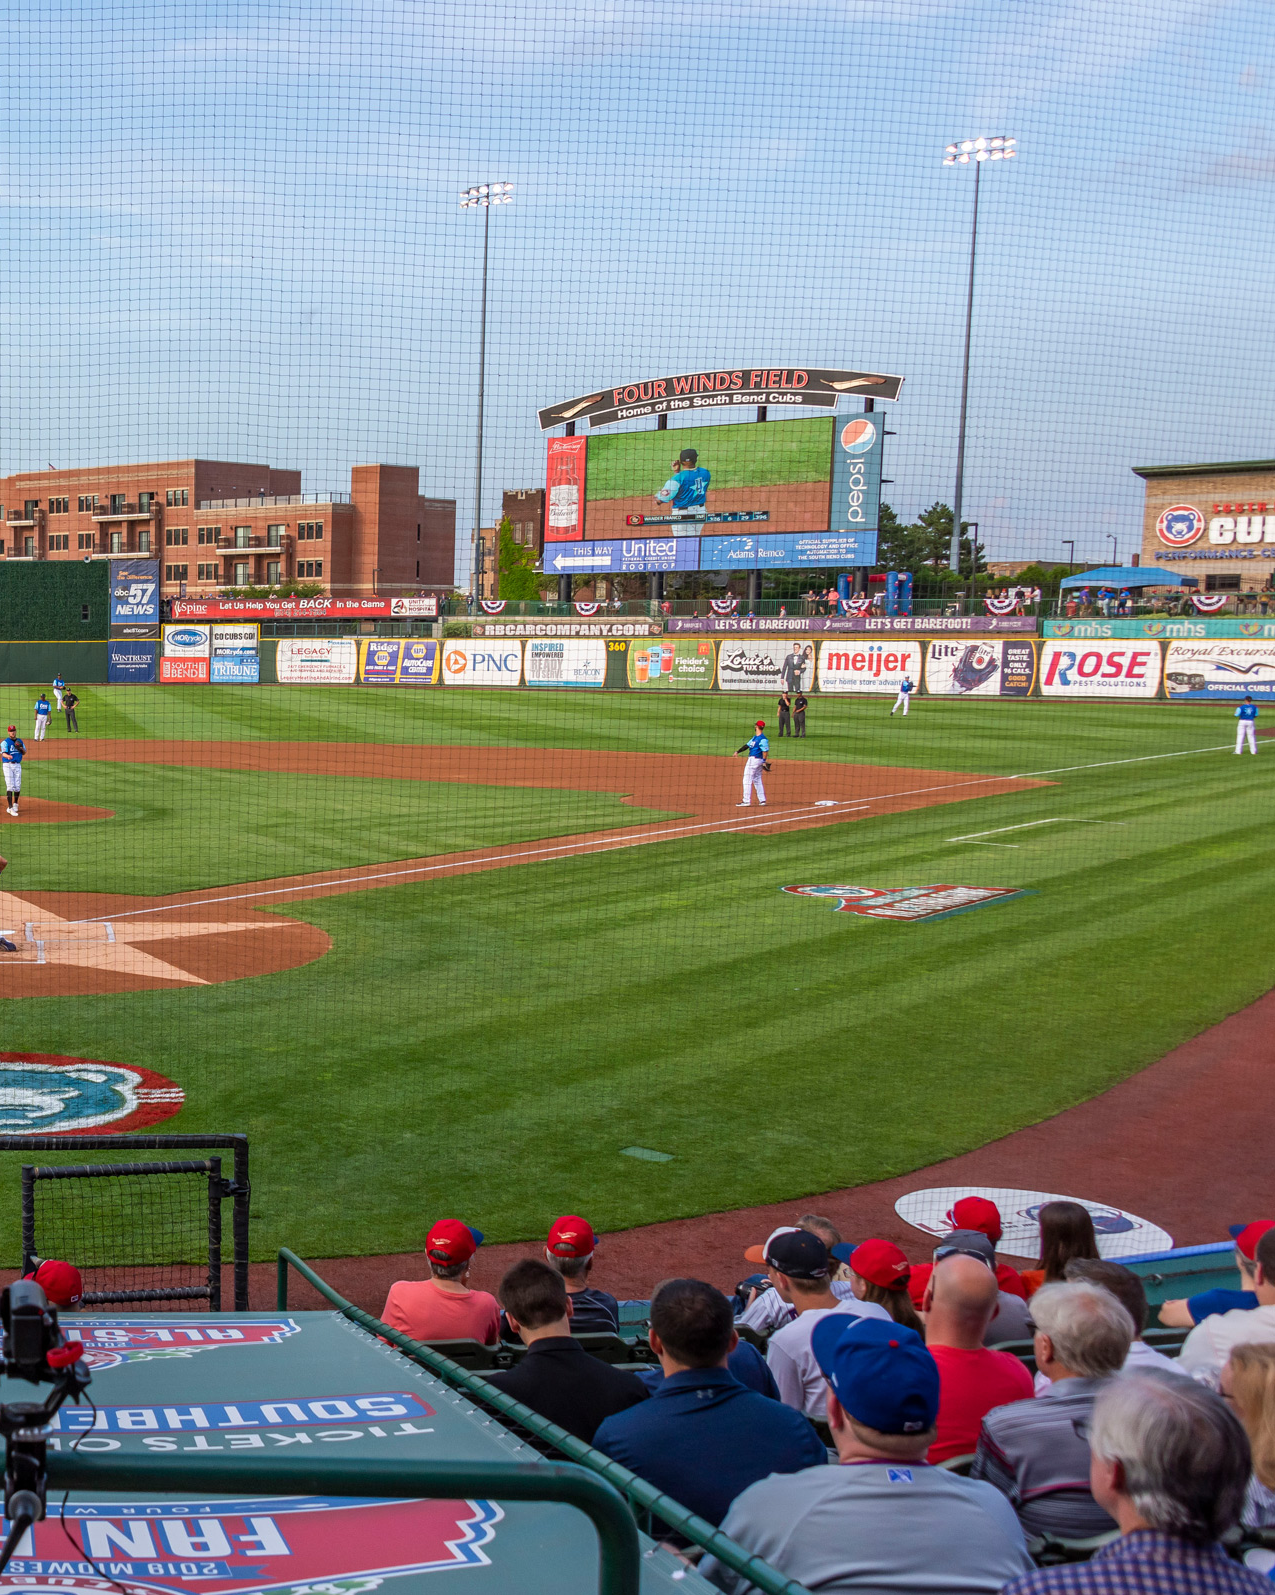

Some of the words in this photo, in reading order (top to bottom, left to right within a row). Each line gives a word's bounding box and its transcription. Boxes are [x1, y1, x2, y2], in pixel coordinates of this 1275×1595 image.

[613, 381, 667, 405] FOUR
[673, 373, 743, 395] WINDS
[749, 371, 809, 389] FIELD
[617, 406, 650, 419] Home
[655, 402, 668, 413] of
[670, 399, 690, 410] the
[693, 395, 729, 407] South
[733, 393, 766, 404] Bend
[769, 392, 802, 403] Cubs
[846, 457, 867, 522] pepsi
[1212, 502, 1267, 514] SOUTH
[573, 547, 592, 555] THIS
[594, 546, 613, 554] WAY
[622, 538, 677, 556] United
[727, 549, 754, 559] Adams
[757, 549, 785, 558] Remco
[1155, 548, 1255, 561] PERFORMANCE
[128, 583, 156, 604] 57
[115, 604, 155, 615] NEWS
[181, 602, 207, 612] Spine
[246, 601, 264, 610] Help
[265, 601, 280, 609] You
[282, 600, 295, 609] Get
[299, 599, 332, 609] BACK
[345, 600, 359, 608] the
[360, 600, 385, 608] Game
[485, 623, 649, 636] RBCARCOMPANY.COM
[714, 619, 738, 629] LET'S
[739, 619, 757, 629] GET
[758, 619, 810, 629] BAREFOOT!
[865, 619, 890, 629] LET'S
[892, 619, 913, 629] GET
[914, 619, 971, 629] BAREFOOT!
[1074, 621, 1112, 637] mhs
[1166, 621, 1205, 637] mhs
[243, 632, 255, 640] GO!
[216, 648, 256, 656] MORryde.com
[369, 643, 398, 652] Ridge
[531, 643, 564, 651] INSPIRED
[608, 642, 626, 651] 360
[930, 643, 958, 660] Lite
[1170, 646, 1214, 658] Royal
[471, 653, 518, 672] PNC
[675, 657, 709, 665] Fielder's
[720, 647, 771, 668] Louie's
[827, 646, 911, 678] meijer
[531, 659, 563, 670] READY
[678, 665, 705, 673] choice
[1043, 651, 1151, 686] ROSE
[171, 669, 198, 677] BEND
[213, 666, 257, 676] TRIBUNE
[532, 670, 540, 678] TO
[542, 670, 564, 678] SERVE
[822, 679, 838, 687] your
[1207, 684, 1247, 692] OFFICIAL
[1248, 684, 1270, 692] CUBS
[142, 1423, 435, 1452] TICKETS
[135, 1505, 212, 1516] FOUR
[81, 1516, 294, 1560] FAN
[163, 1561, 220, 1576] 2019
